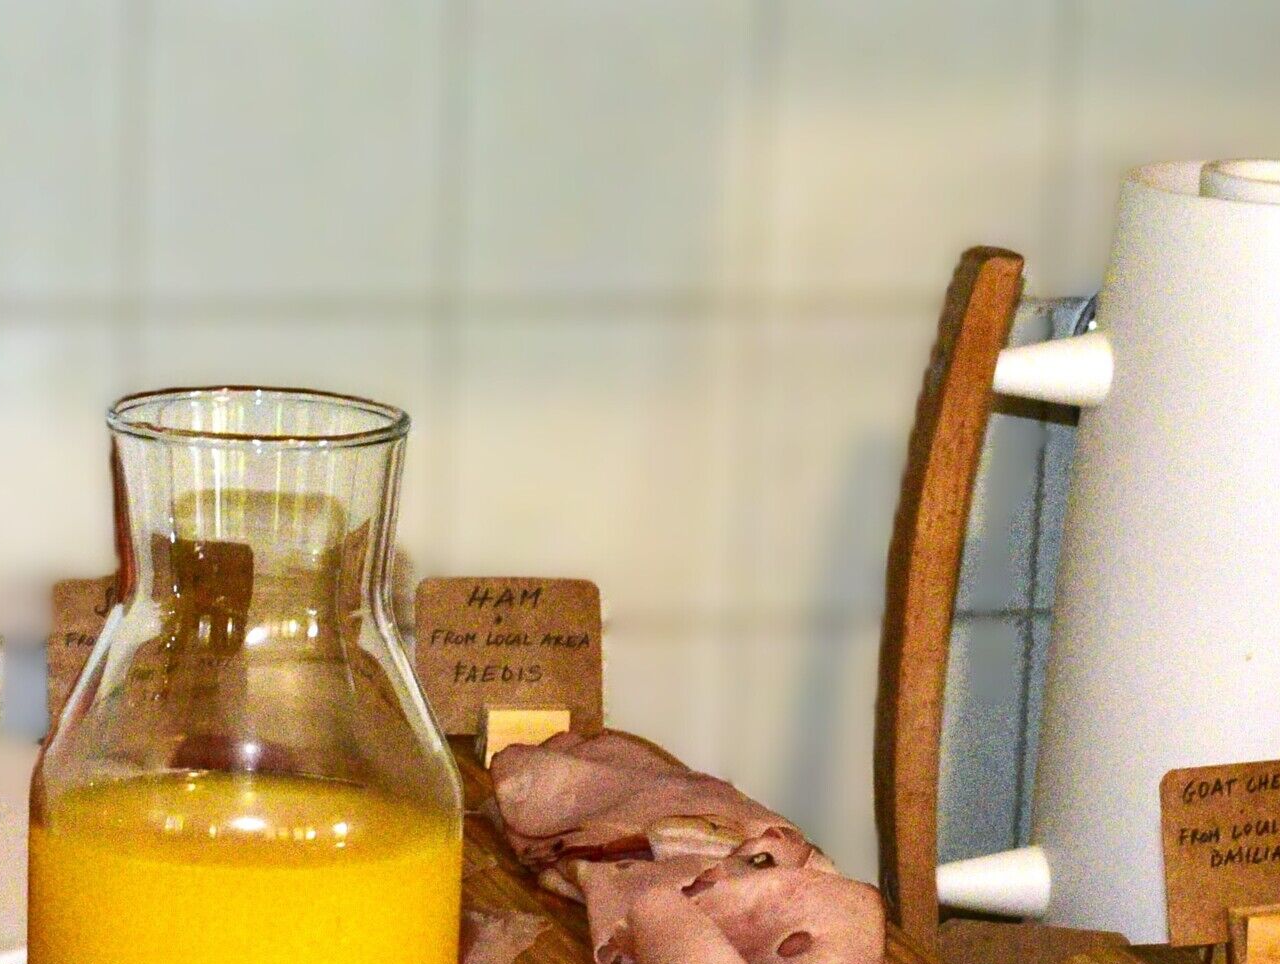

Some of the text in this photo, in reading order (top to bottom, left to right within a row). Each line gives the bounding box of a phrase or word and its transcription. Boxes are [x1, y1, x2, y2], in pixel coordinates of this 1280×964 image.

[467, 585, 543, 609] HAM
[429, 627, 591, 650] FROM LOCAL AREA
[453, 660, 543, 684] FAEDIS
[1182, 778, 1238, 805] GOAT
[1178, 827, 1221, 846] FROM
[1231, 818, 1278, 840] LOCAL
